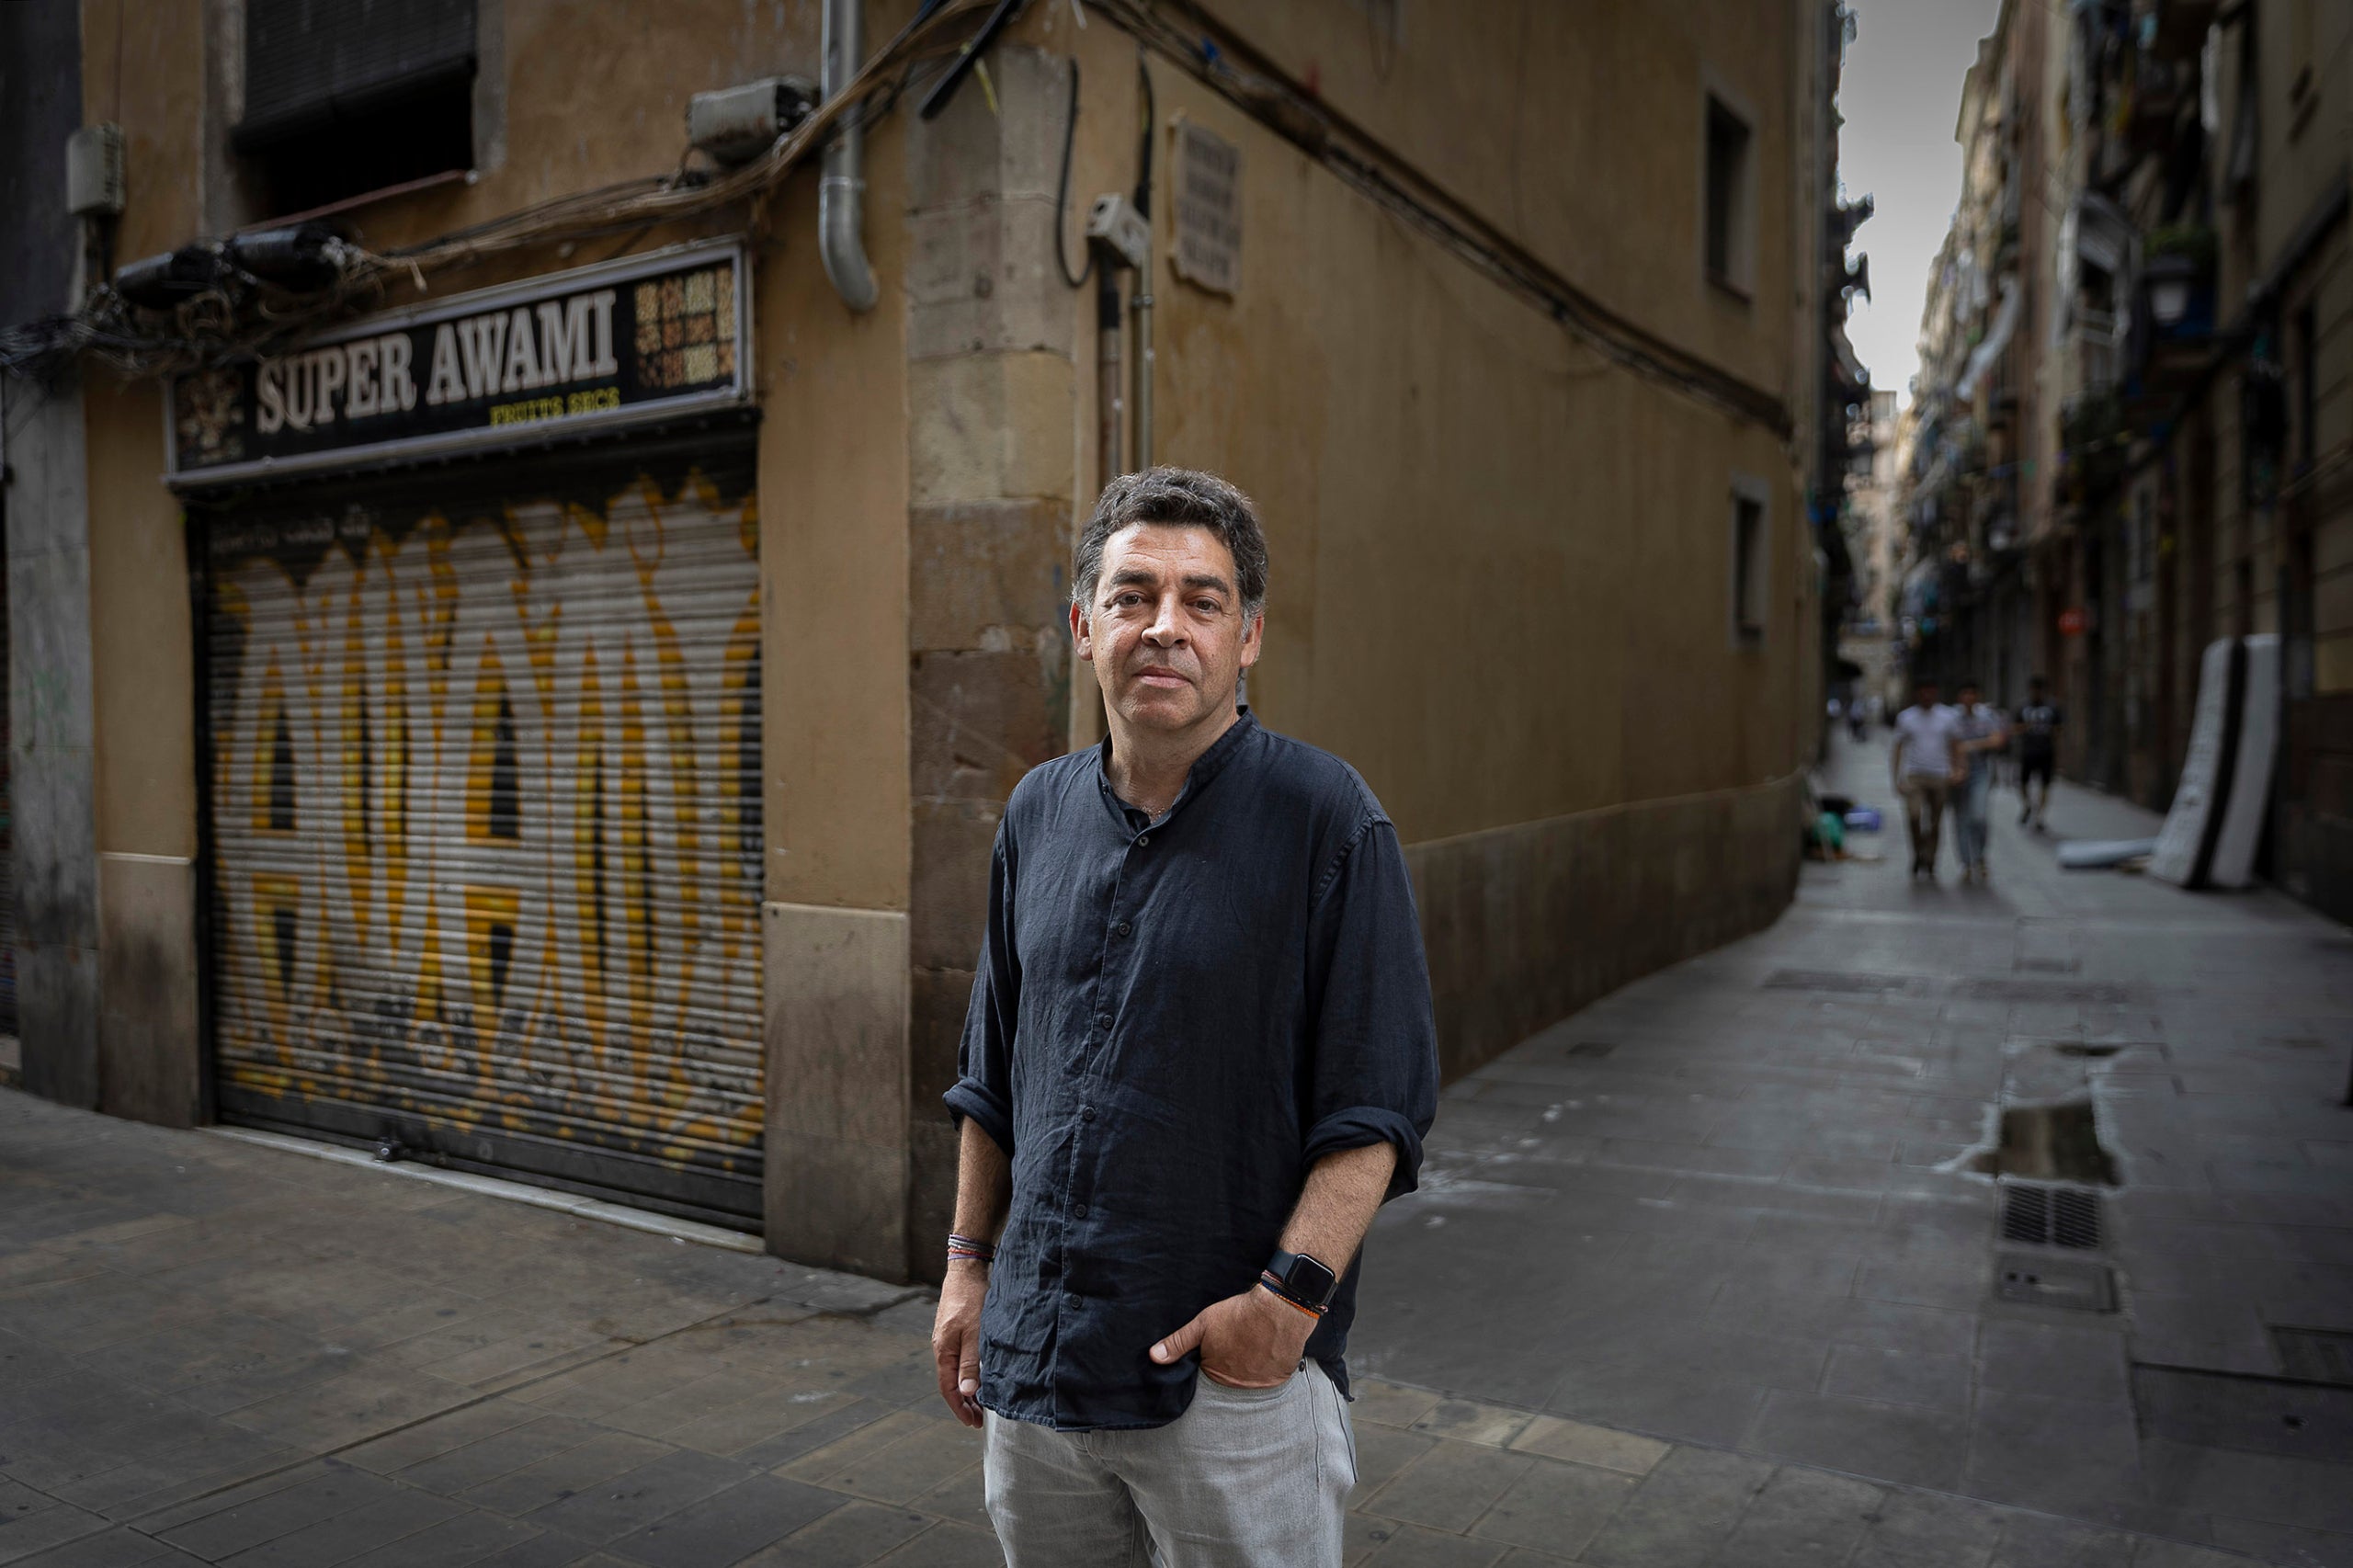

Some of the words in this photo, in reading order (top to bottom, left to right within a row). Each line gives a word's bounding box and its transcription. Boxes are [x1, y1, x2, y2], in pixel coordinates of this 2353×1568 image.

[257, 334, 415, 434] SUPER
[426, 291, 617, 404] AWAMI
[490, 396, 563, 426] FRUITS
[567, 387, 620, 414] SECS
